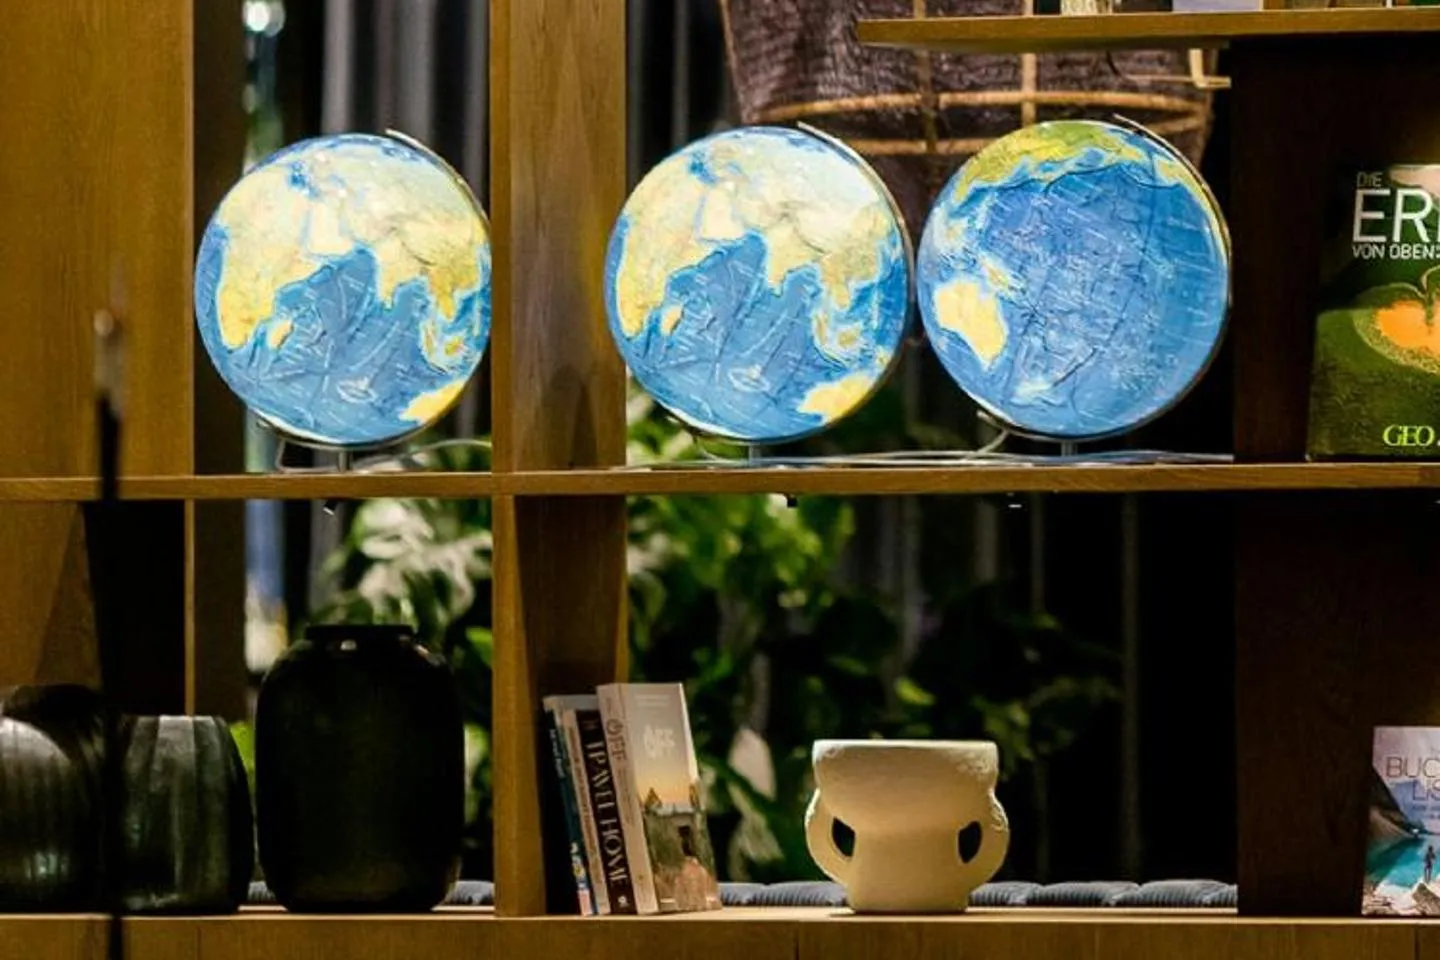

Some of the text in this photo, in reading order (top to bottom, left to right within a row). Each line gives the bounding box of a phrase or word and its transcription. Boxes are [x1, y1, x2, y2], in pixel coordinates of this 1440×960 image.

[1356, 171, 1383, 188] DIE
[1352, 243, 1435, 260] VON OBEN
[1382, 424, 1435, 446] GEO
